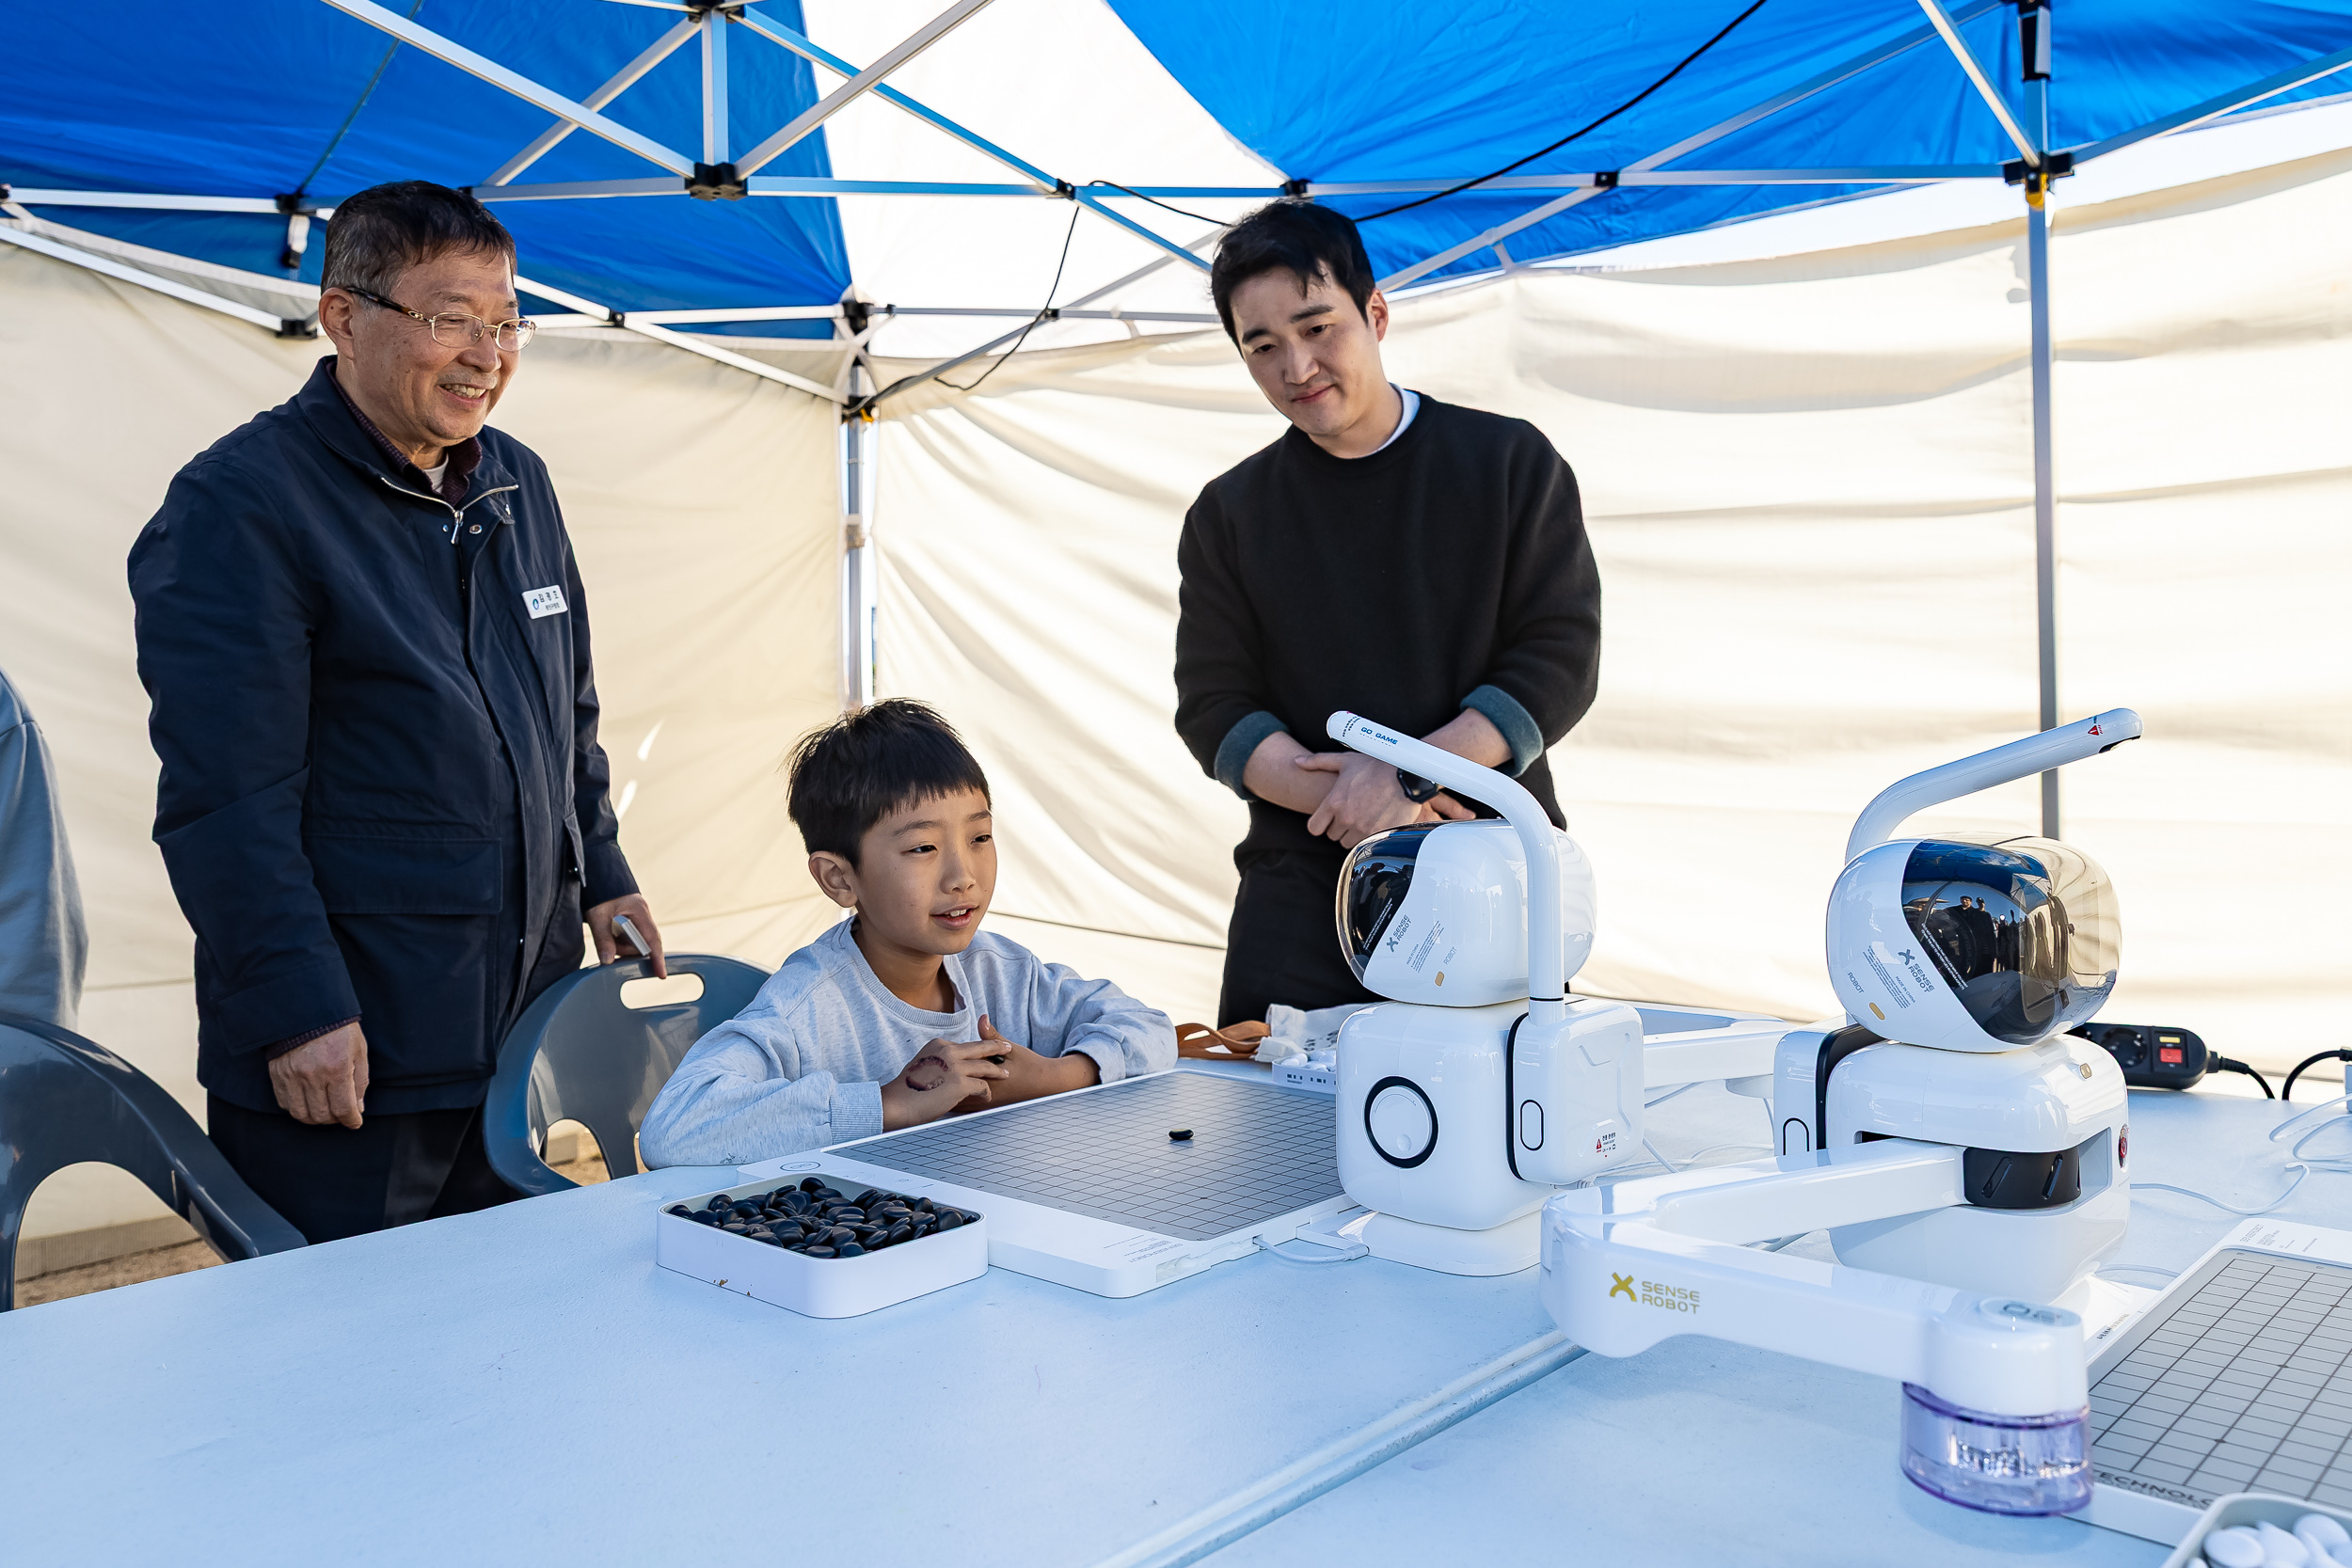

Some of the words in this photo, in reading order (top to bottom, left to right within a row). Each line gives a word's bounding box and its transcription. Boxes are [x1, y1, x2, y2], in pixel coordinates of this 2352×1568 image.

[1360, 726, 1374, 735] GO
[1375, 732, 1399, 745] GAME
[1393, 914, 1409, 938] SENSE
[1396, 919, 1412, 941] ROBOT
[1442, 946, 1457, 966] ROBOT
[1847, 972, 1865, 994] ROBOT
[1907, 965, 1931, 993] ROBOT
[1913, 962, 1935, 991] SENSE
[1895, 975, 1905, 988] MADE
[1905, 990, 1916, 1004] CHINA
[1641, 1280, 1700, 1303] SENSE
[1642, 1293, 1700, 1315] ROBOT
